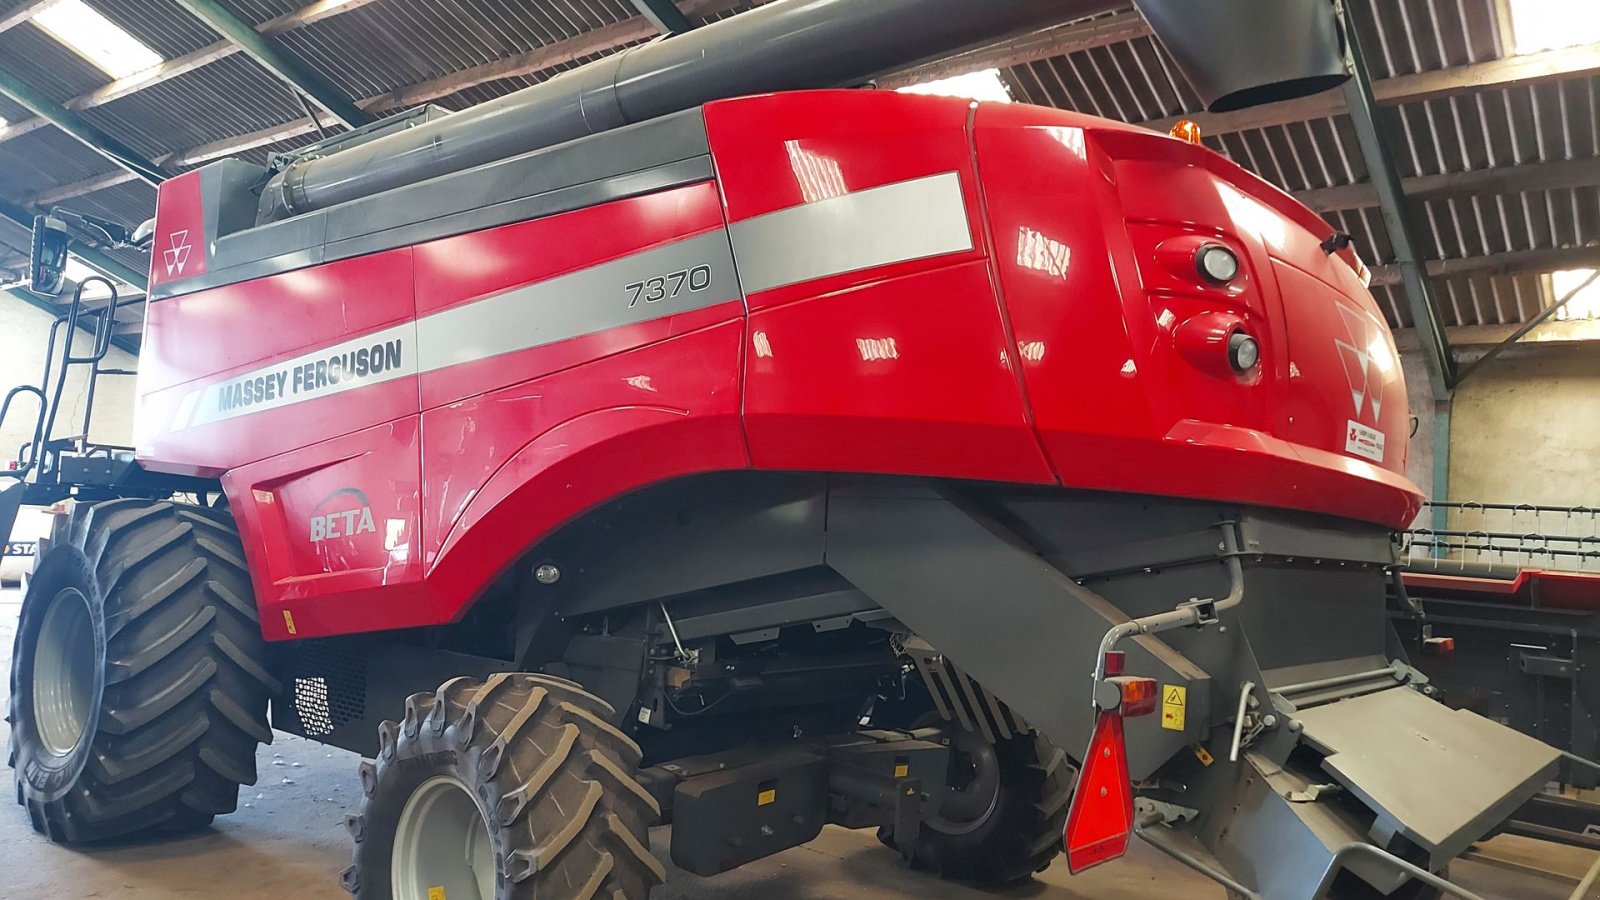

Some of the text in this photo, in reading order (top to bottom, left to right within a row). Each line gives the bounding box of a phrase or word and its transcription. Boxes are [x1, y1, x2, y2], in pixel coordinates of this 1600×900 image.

[624, 263, 712, 309] 7370
[218, 338, 402, 412] MASSEY FERGUSON
[310, 506, 376, 542] BETA
